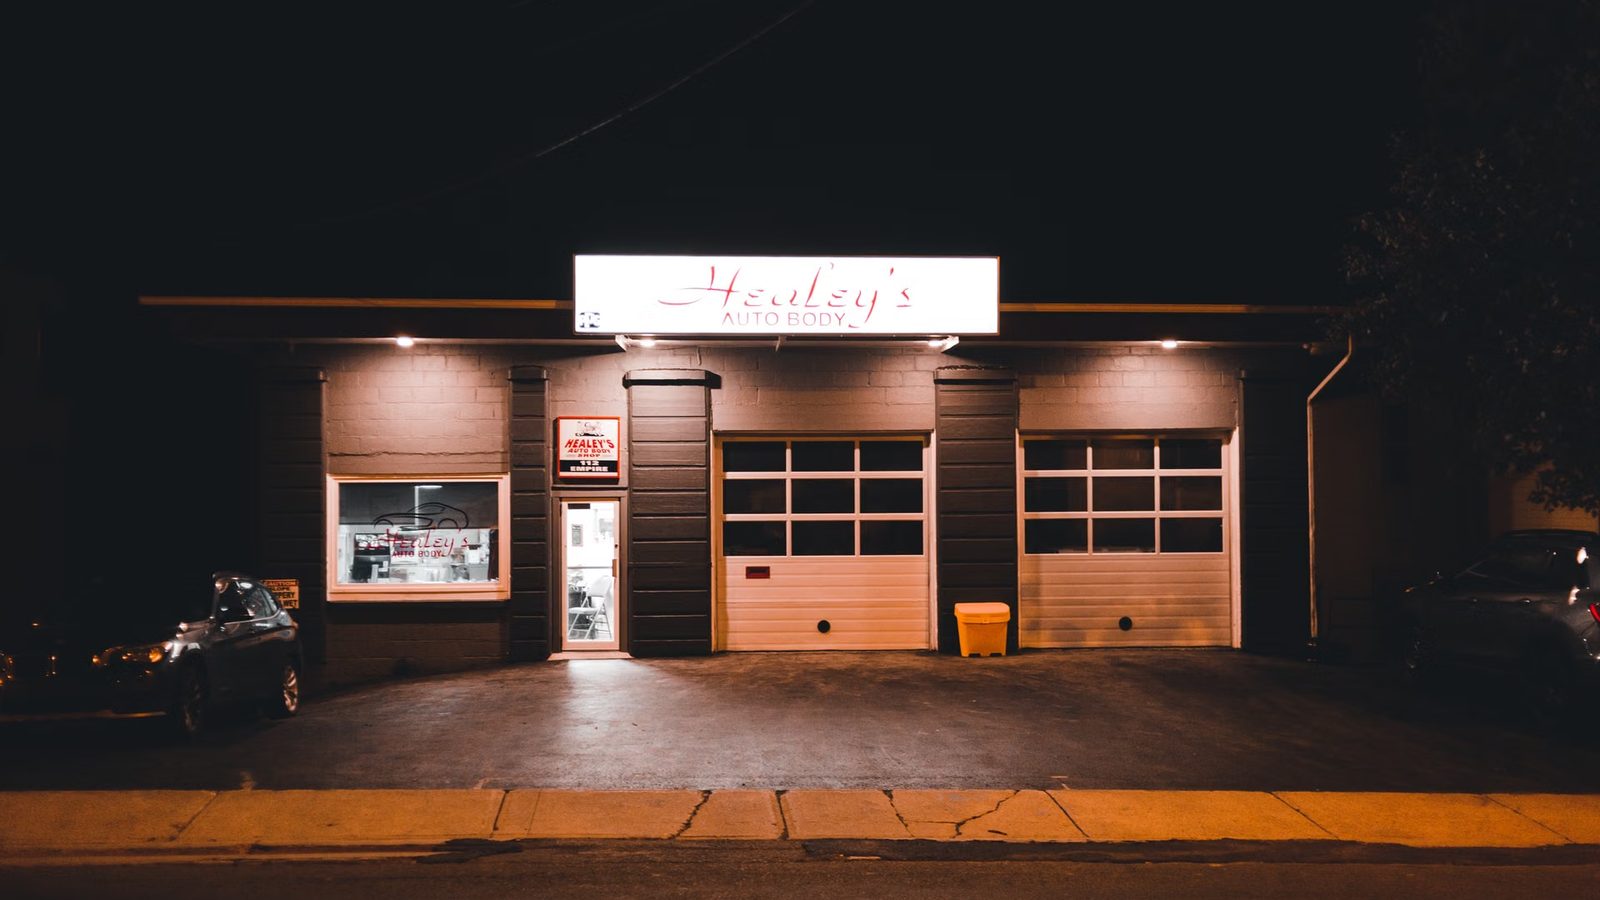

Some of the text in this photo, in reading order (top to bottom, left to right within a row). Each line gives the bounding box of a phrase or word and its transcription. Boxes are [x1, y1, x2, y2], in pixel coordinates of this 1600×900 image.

[721, 311, 846, 327] AUTO BODY
[564, 439, 615, 448] HEALEY'S
[391, 549, 442, 558] AUTO BODY
